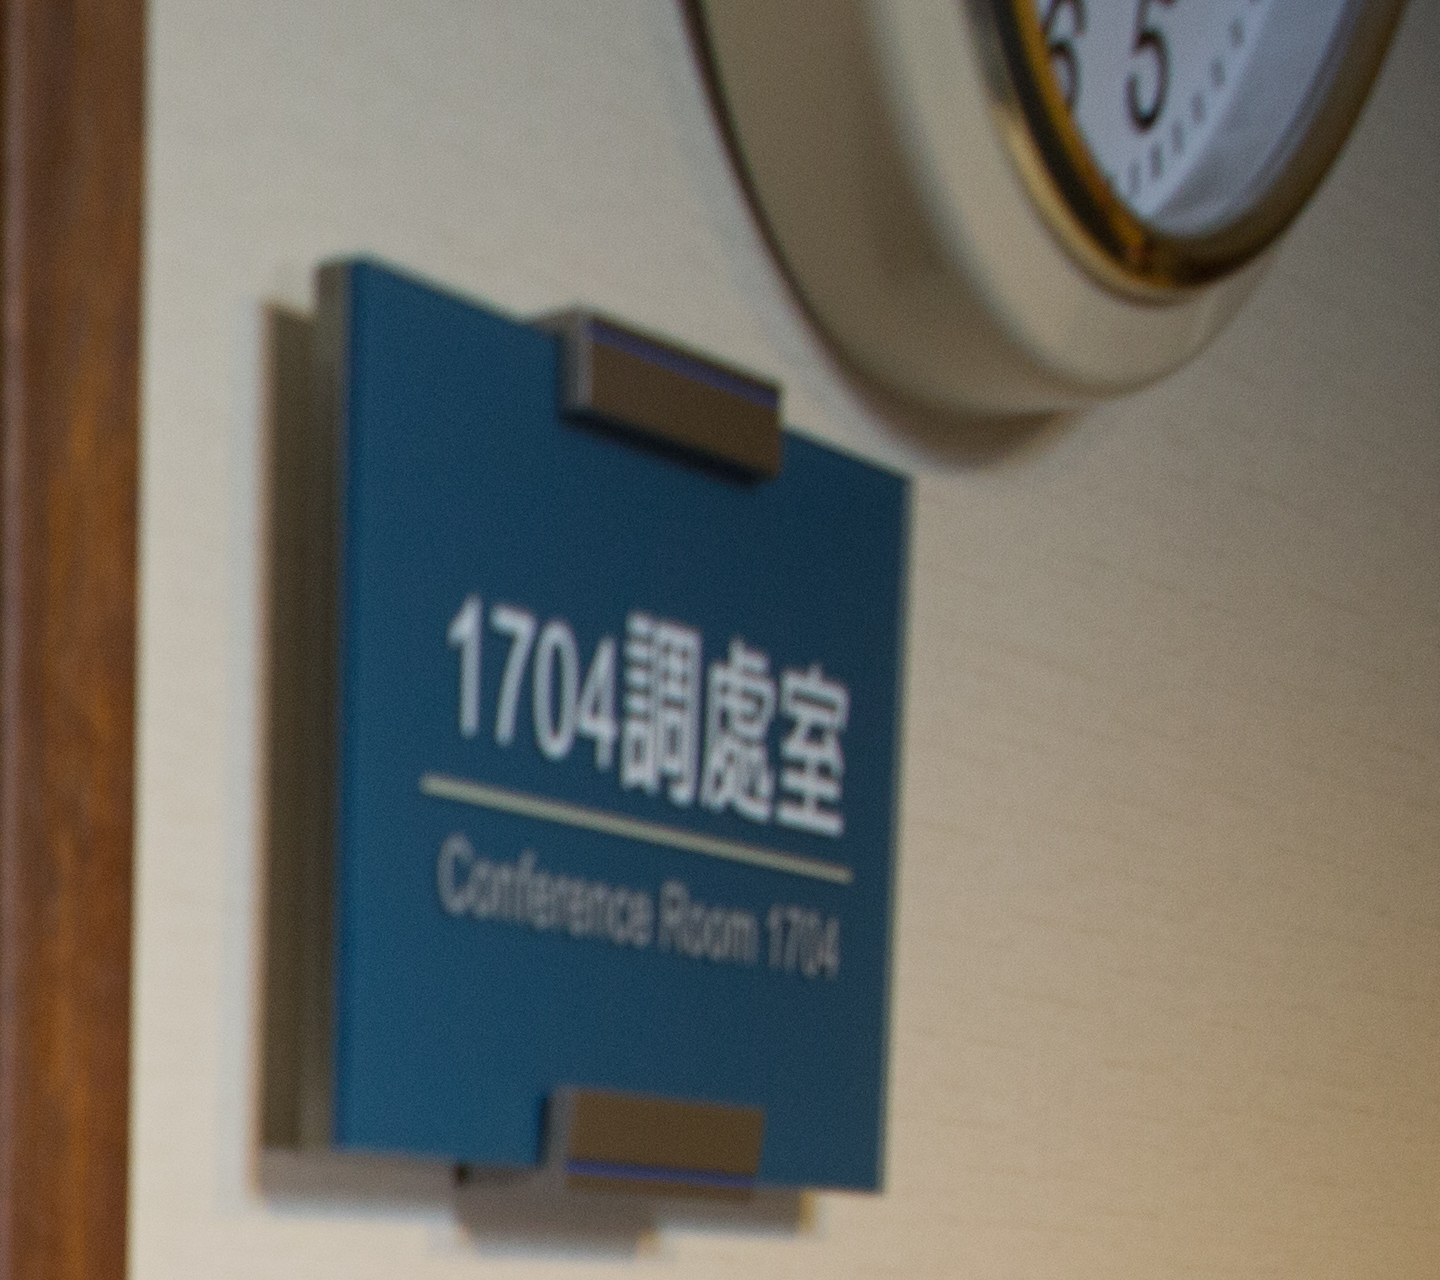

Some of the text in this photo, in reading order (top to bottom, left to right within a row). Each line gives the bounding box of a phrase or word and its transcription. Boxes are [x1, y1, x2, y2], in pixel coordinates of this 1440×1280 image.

[1125, 0, 1174, 131] 5
[447, 595, 851, 837] 1704調處室
[438, 835, 842, 982] Conference Room 1704
